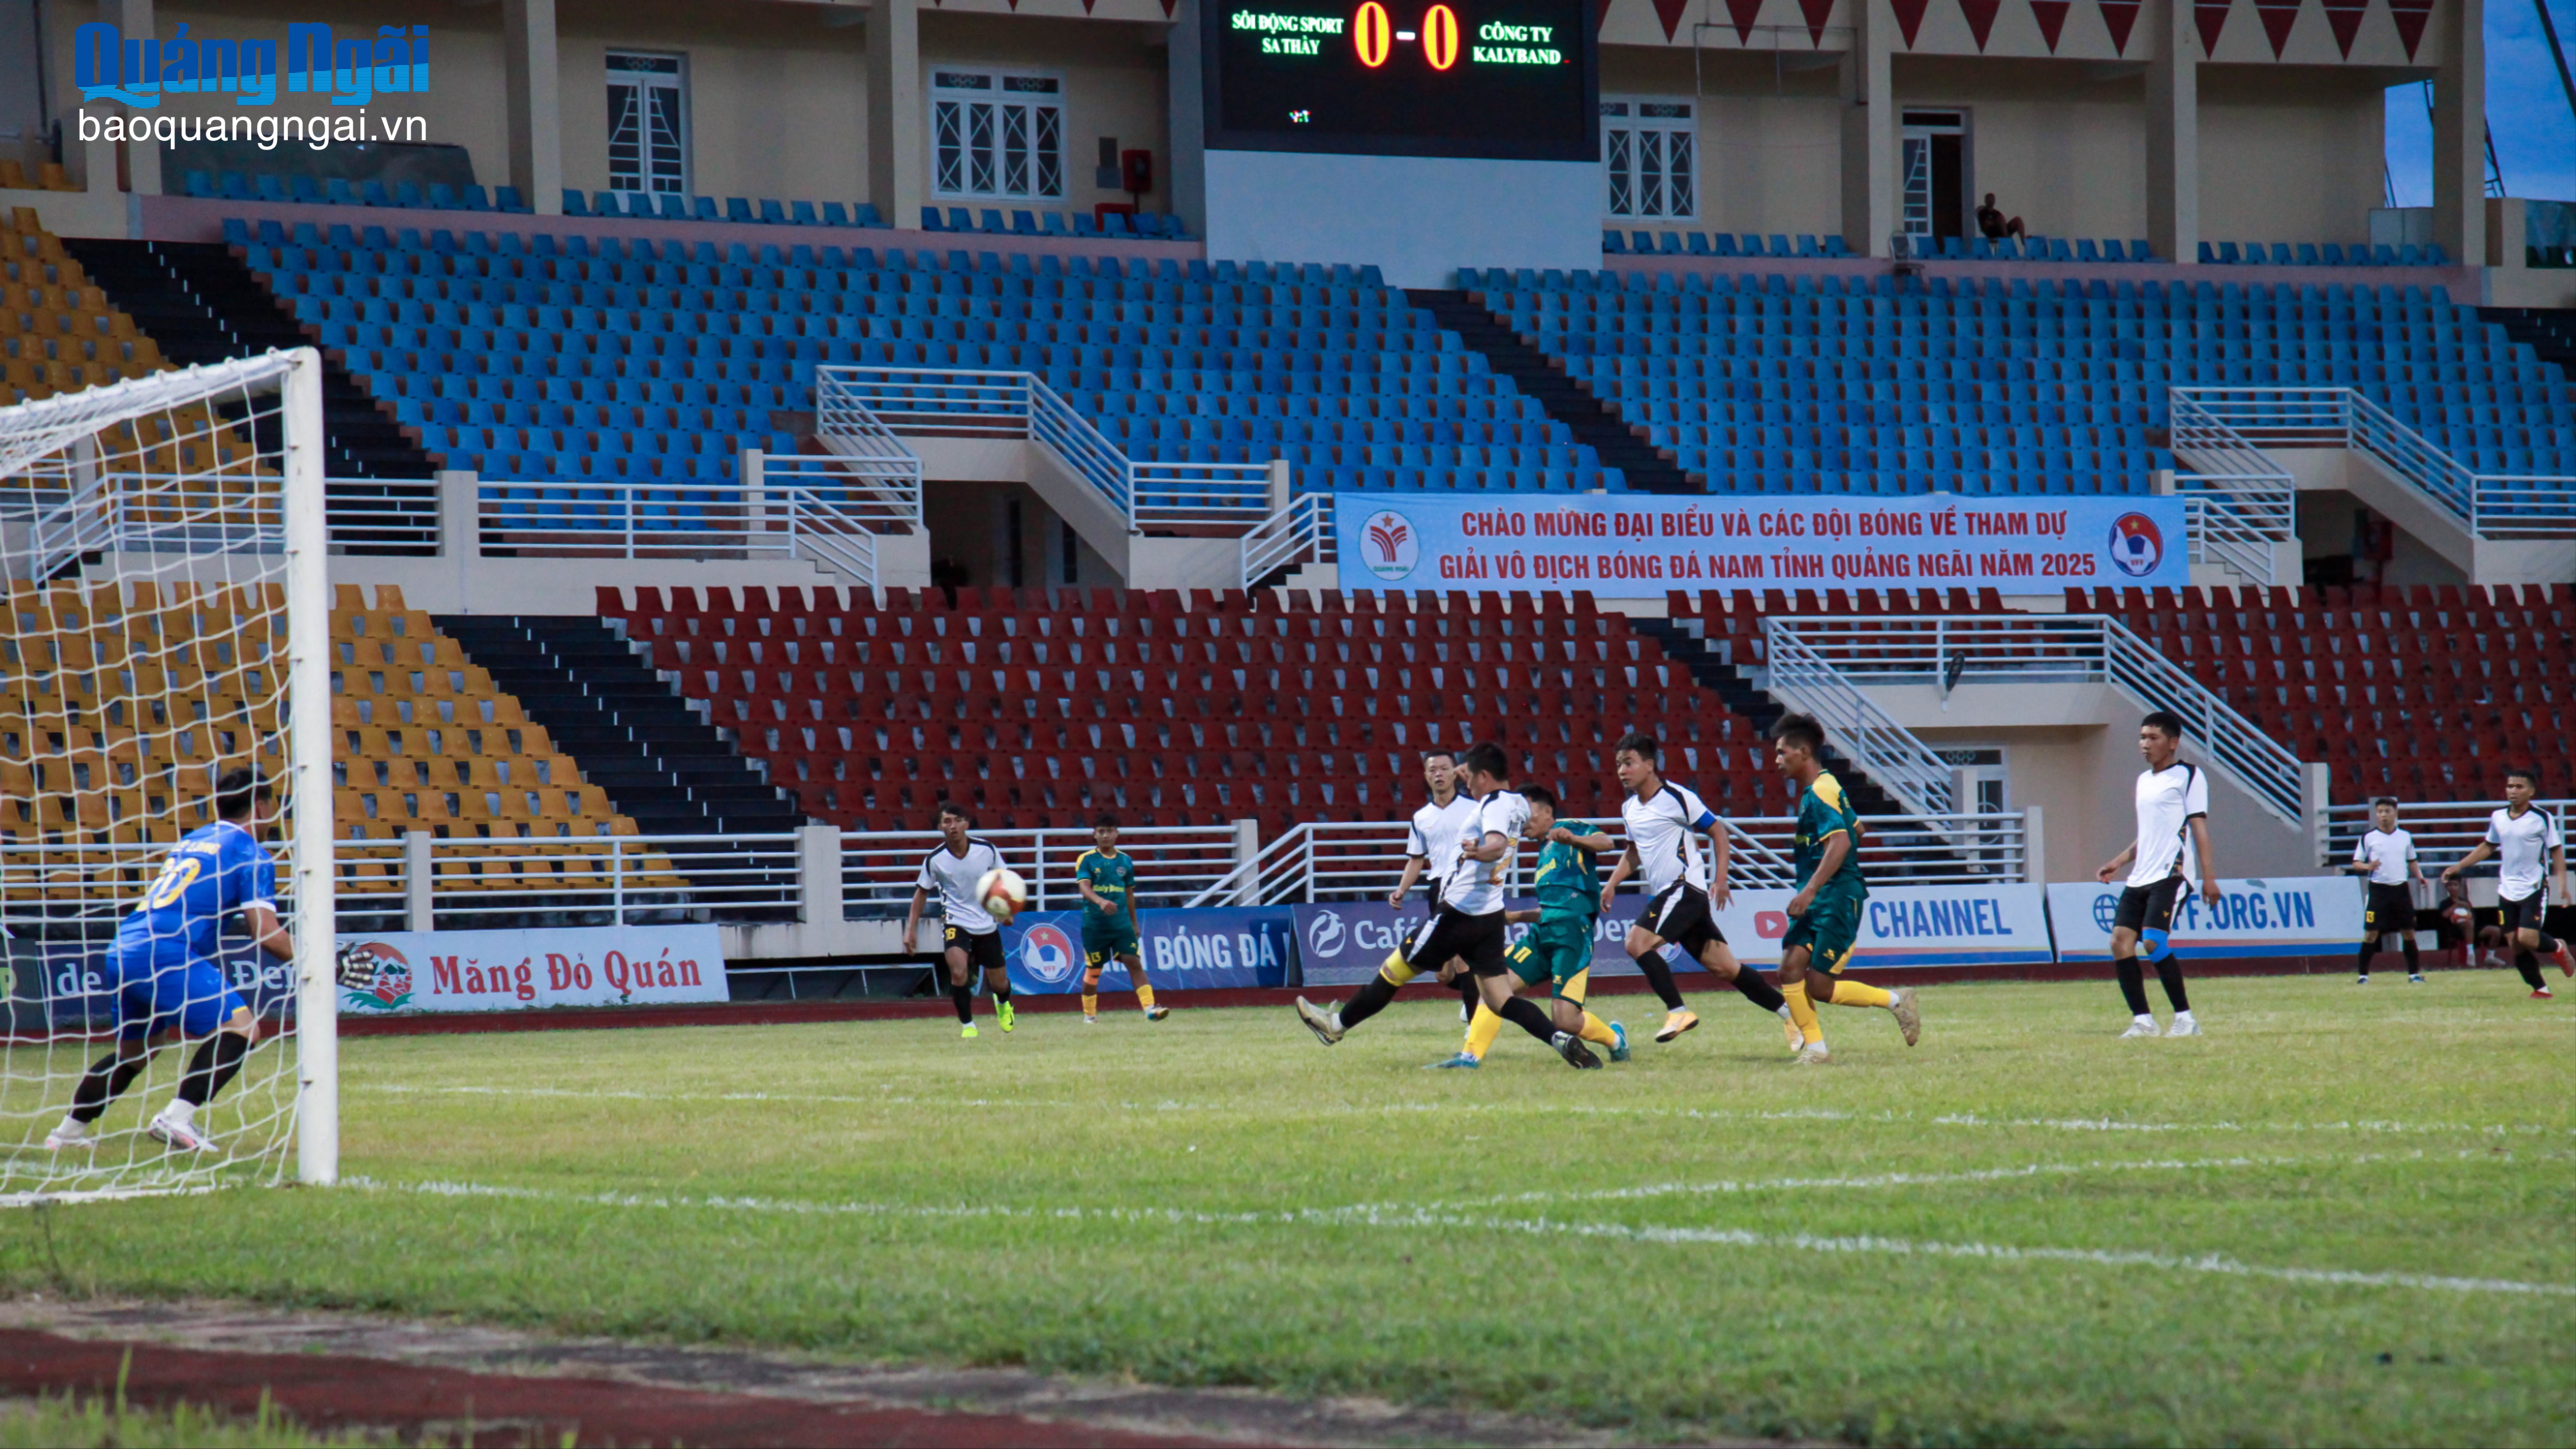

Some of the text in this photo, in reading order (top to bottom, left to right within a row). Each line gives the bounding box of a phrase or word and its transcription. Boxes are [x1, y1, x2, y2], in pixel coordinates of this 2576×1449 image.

[1232, 10, 1344, 35] SÔI ĐỘNG SPORT
[1479, 20, 1553, 42] CÔNG TY
[1262, 37, 1281, 53] SA
[1472, 46, 1561, 65] KALYBAND
[1462, 503, 2067, 542] CHÀO MỪNG ĐẠI BIỂU VÀ CÁC ĐỘI BÓNG VỀ THAM DỰ
[1440, 546, 2096, 584] GIẢI VÔ ĐỊCH BÓNG ĐÁ NAM TỈNH QUẢNG NGÃI NĂM 2025
[1869, 898, 2013, 939] CHANNEL
[2172, 891, 2315, 932] F.ORG.VN
[1154, 925, 1234, 970] BÓNG
[1238, 922, 1279, 968] ĐÁ
[56, 963, 103, 996] de
[429, 947, 702, 1001] Măng Đỏ Quán
